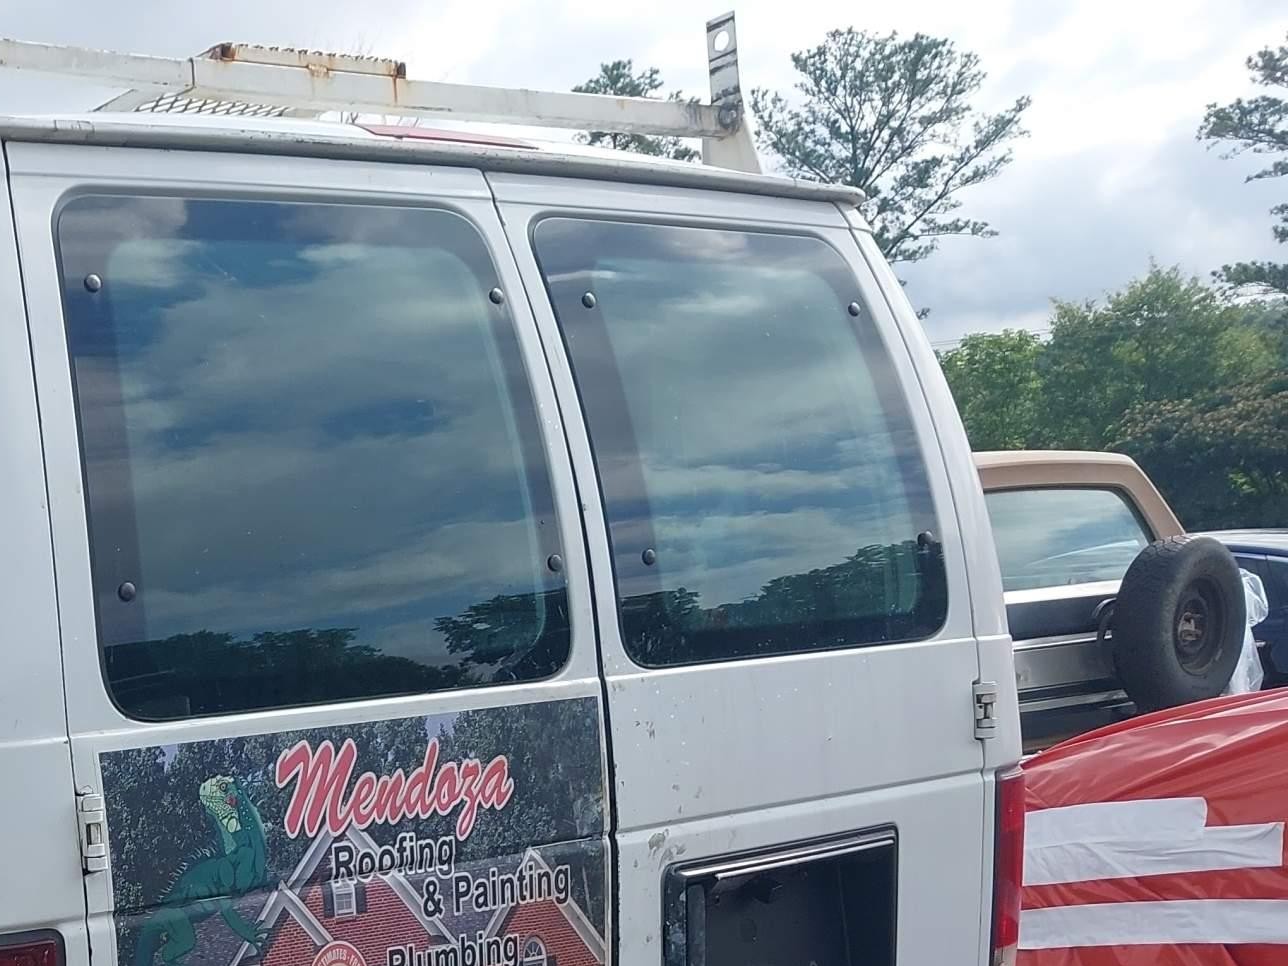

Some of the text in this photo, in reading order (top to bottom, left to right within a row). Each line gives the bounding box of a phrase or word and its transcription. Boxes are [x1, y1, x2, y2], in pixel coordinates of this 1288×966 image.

[276, 738, 513, 840] Mendoza
[332, 832, 455, 885] Roofing
[423, 860, 571, 918] & Painting
